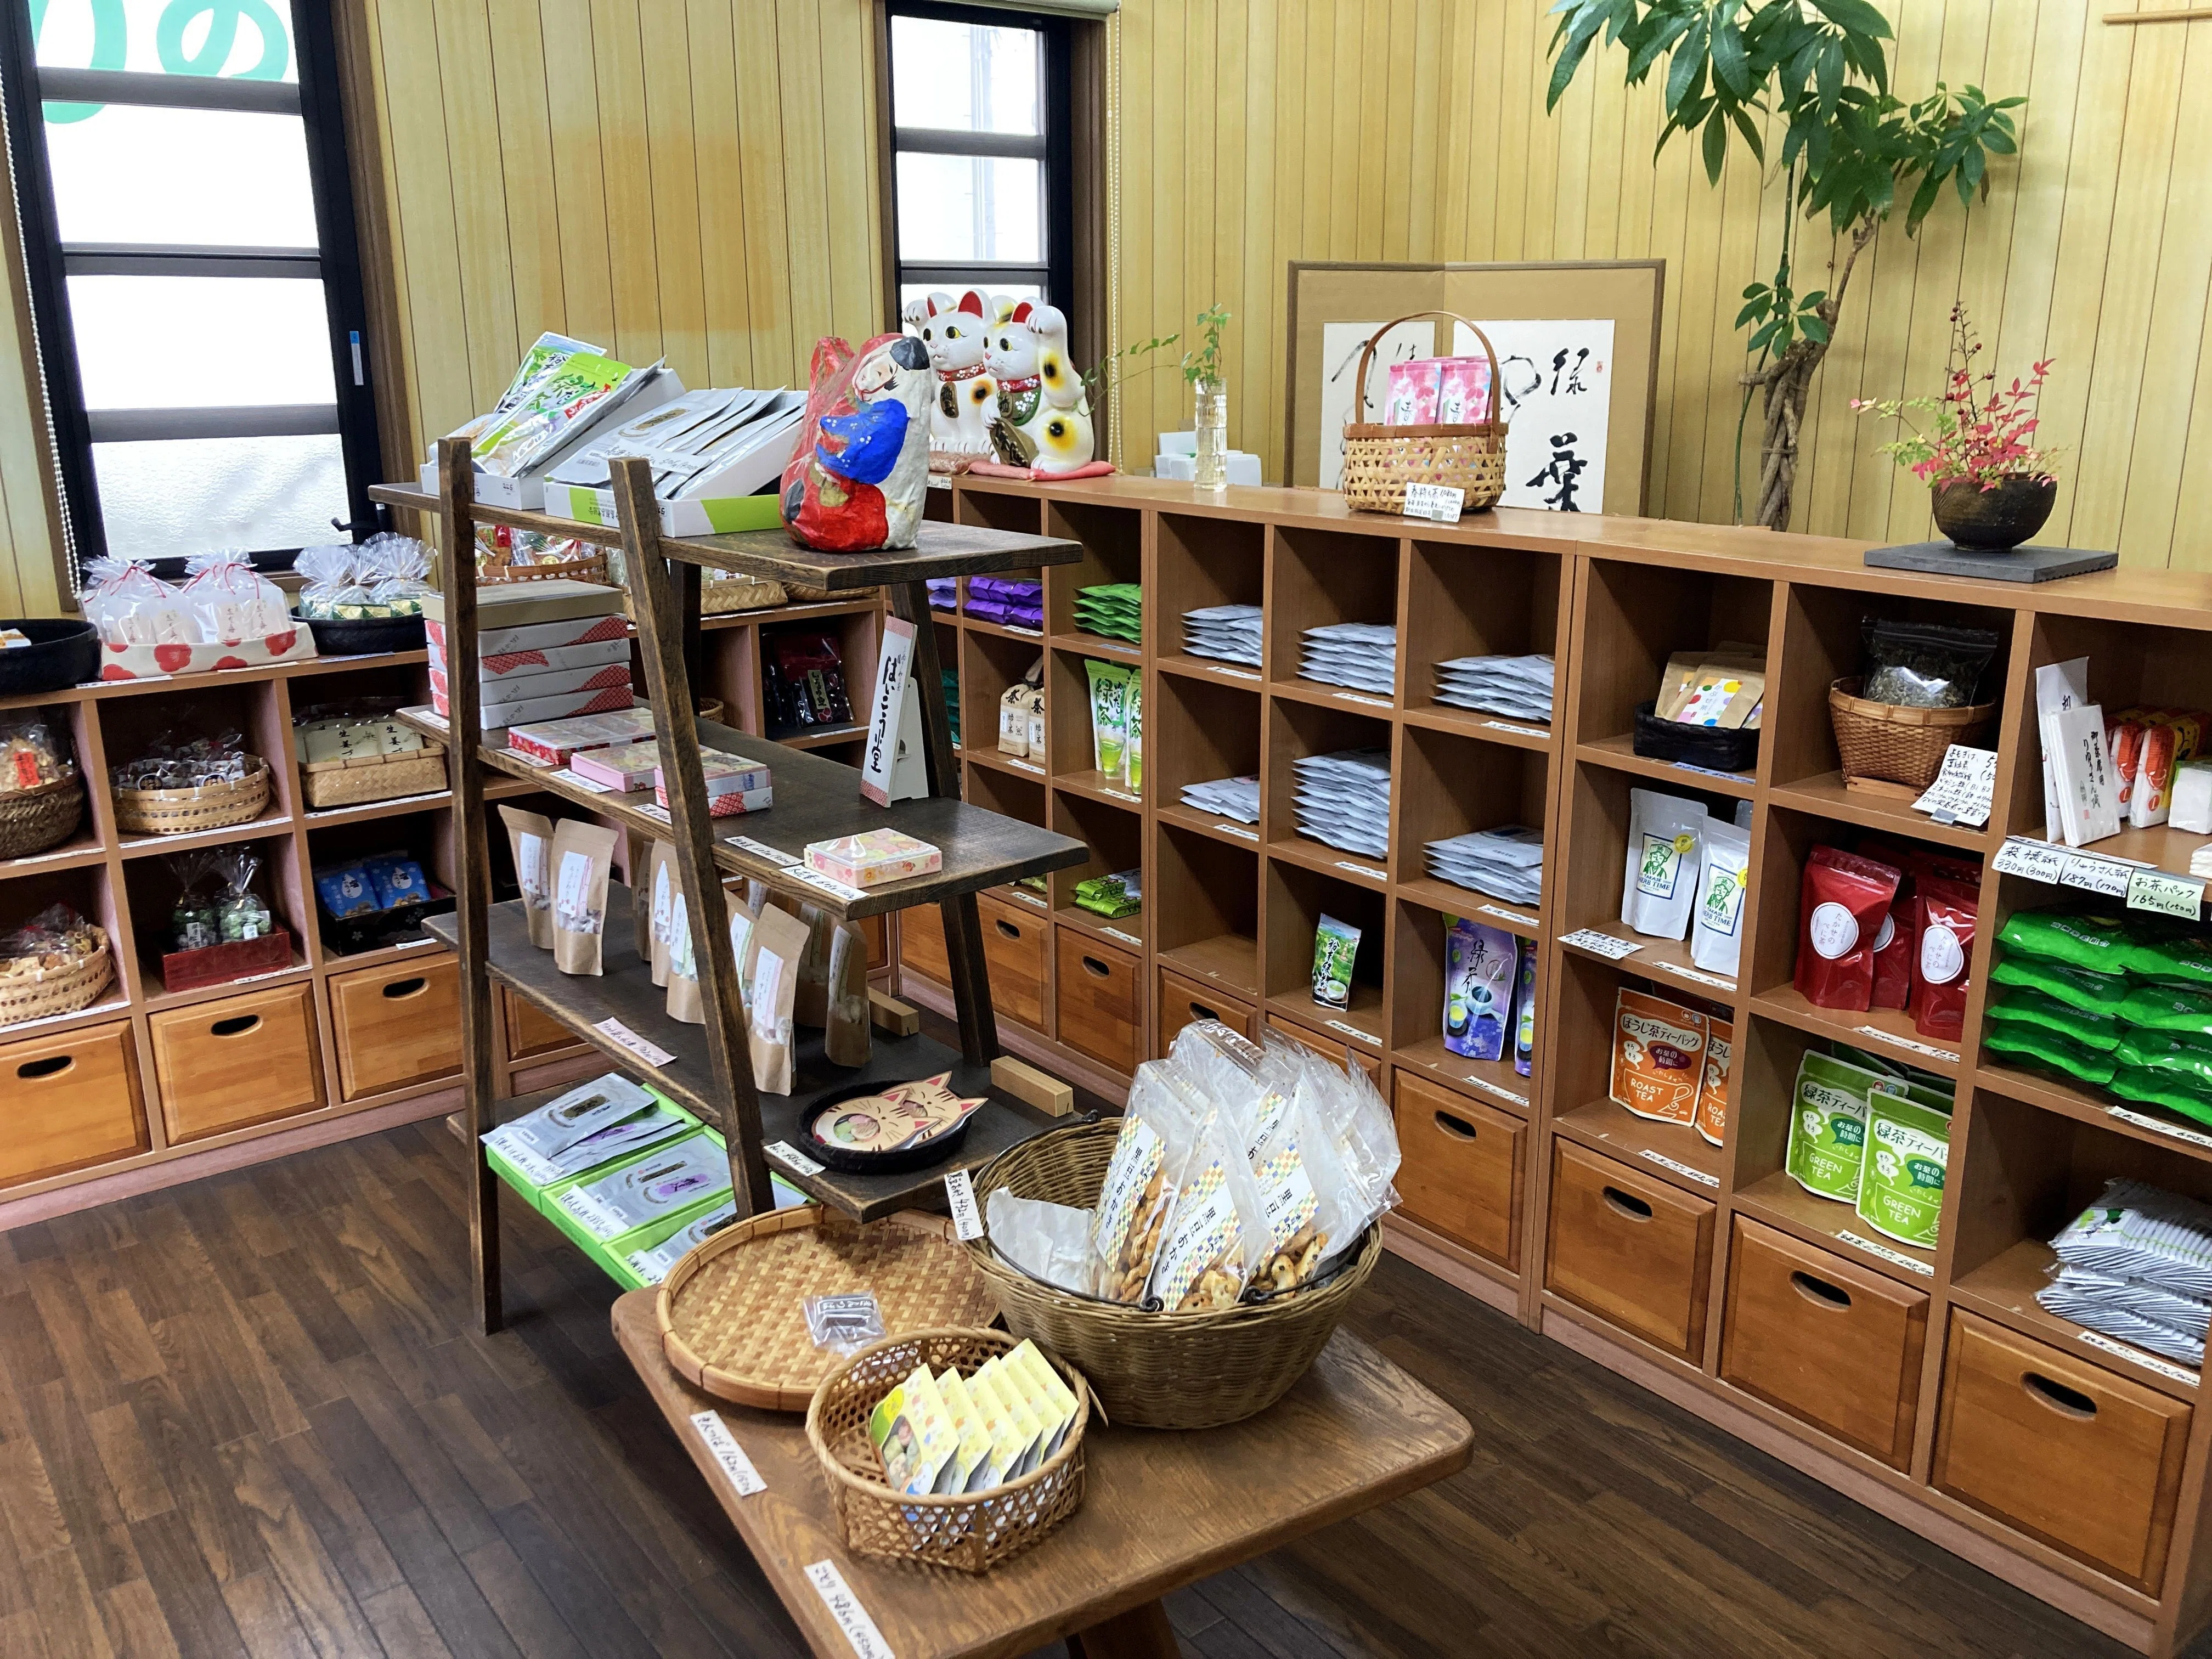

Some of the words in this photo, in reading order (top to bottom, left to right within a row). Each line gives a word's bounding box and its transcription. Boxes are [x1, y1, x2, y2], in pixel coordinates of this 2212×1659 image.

[1005, 689, 1020, 705] 茶
[1651, 879, 1672, 891] TIME
[2135, 877, 2196, 899] お茶パック
[1713, 914, 1732, 927] TIME
[1622, 1015, 1699, 1048] ほうじ茶ティーバッグ
[1655, 1048, 1678, 1059] お茶の
[1630, 1077, 1664, 1096] ROAST
[1636, 1090, 1654, 1102] TEA
[1707, 1102, 1725, 1119] ROA
[1837, 1121, 1861, 1135] お茶の
[1839, 1130, 1862, 1143] 時間に
[1876, 1122, 1948, 1161] 緑茶ティーバ
[1809, 1152, 1843, 1174] GREEN
[1913, 1162, 1940, 1177] お茶の
[1812, 1167, 1831, 1181] TEA
[1916, 1173, 1941, 1186] 時間に
[1105, 1147, 1143, 1229] 黒豆おかき
[1882, 1194, 1921, 1218] GREEN
[1888, 1209, 1910, 1226] TEA
[1162, 1206, 1217, 1274] 黒豆おかき
